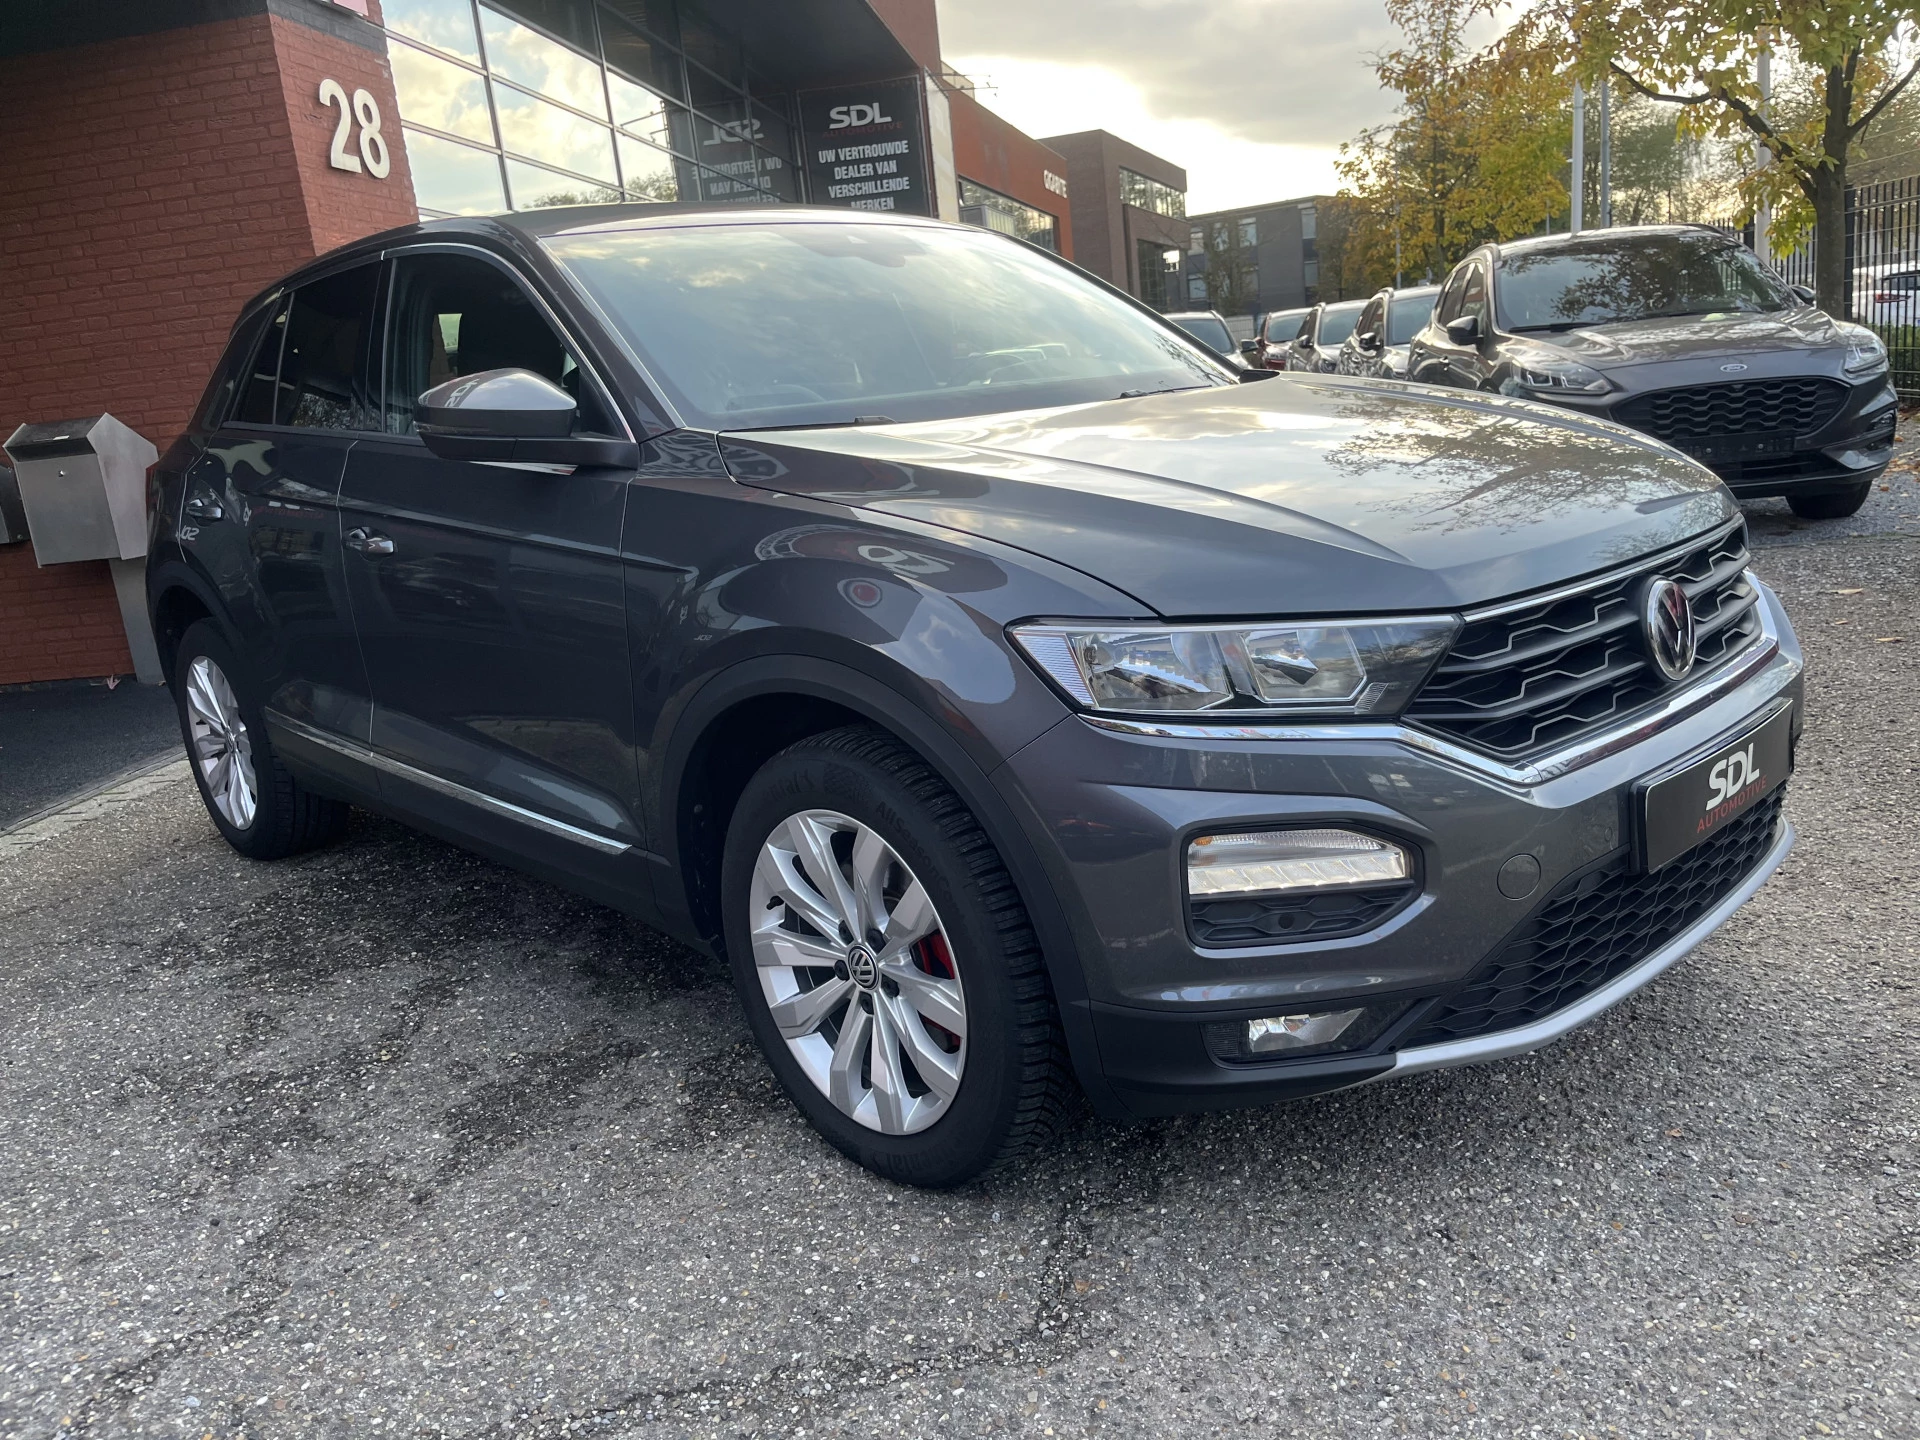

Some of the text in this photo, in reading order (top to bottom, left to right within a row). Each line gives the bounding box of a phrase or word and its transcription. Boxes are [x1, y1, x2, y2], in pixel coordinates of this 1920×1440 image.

[828, 102, 893, 129] SDL
[319, 78, 390, 179] 28
[822, 121, 904, 138] AUTOMOTIVE
[818, 140, 910, 164] UW VERTROUWDE
[834, 159, 898, 181] DEALER VAN
[828, 177, 911, 199] VERSCHILLENDE
[851, 196, 895, 211] MERKEN
[1705, 742, 1759, 811] SDL
[1697, 775, 1767, 834] AUTOMOTIVE
